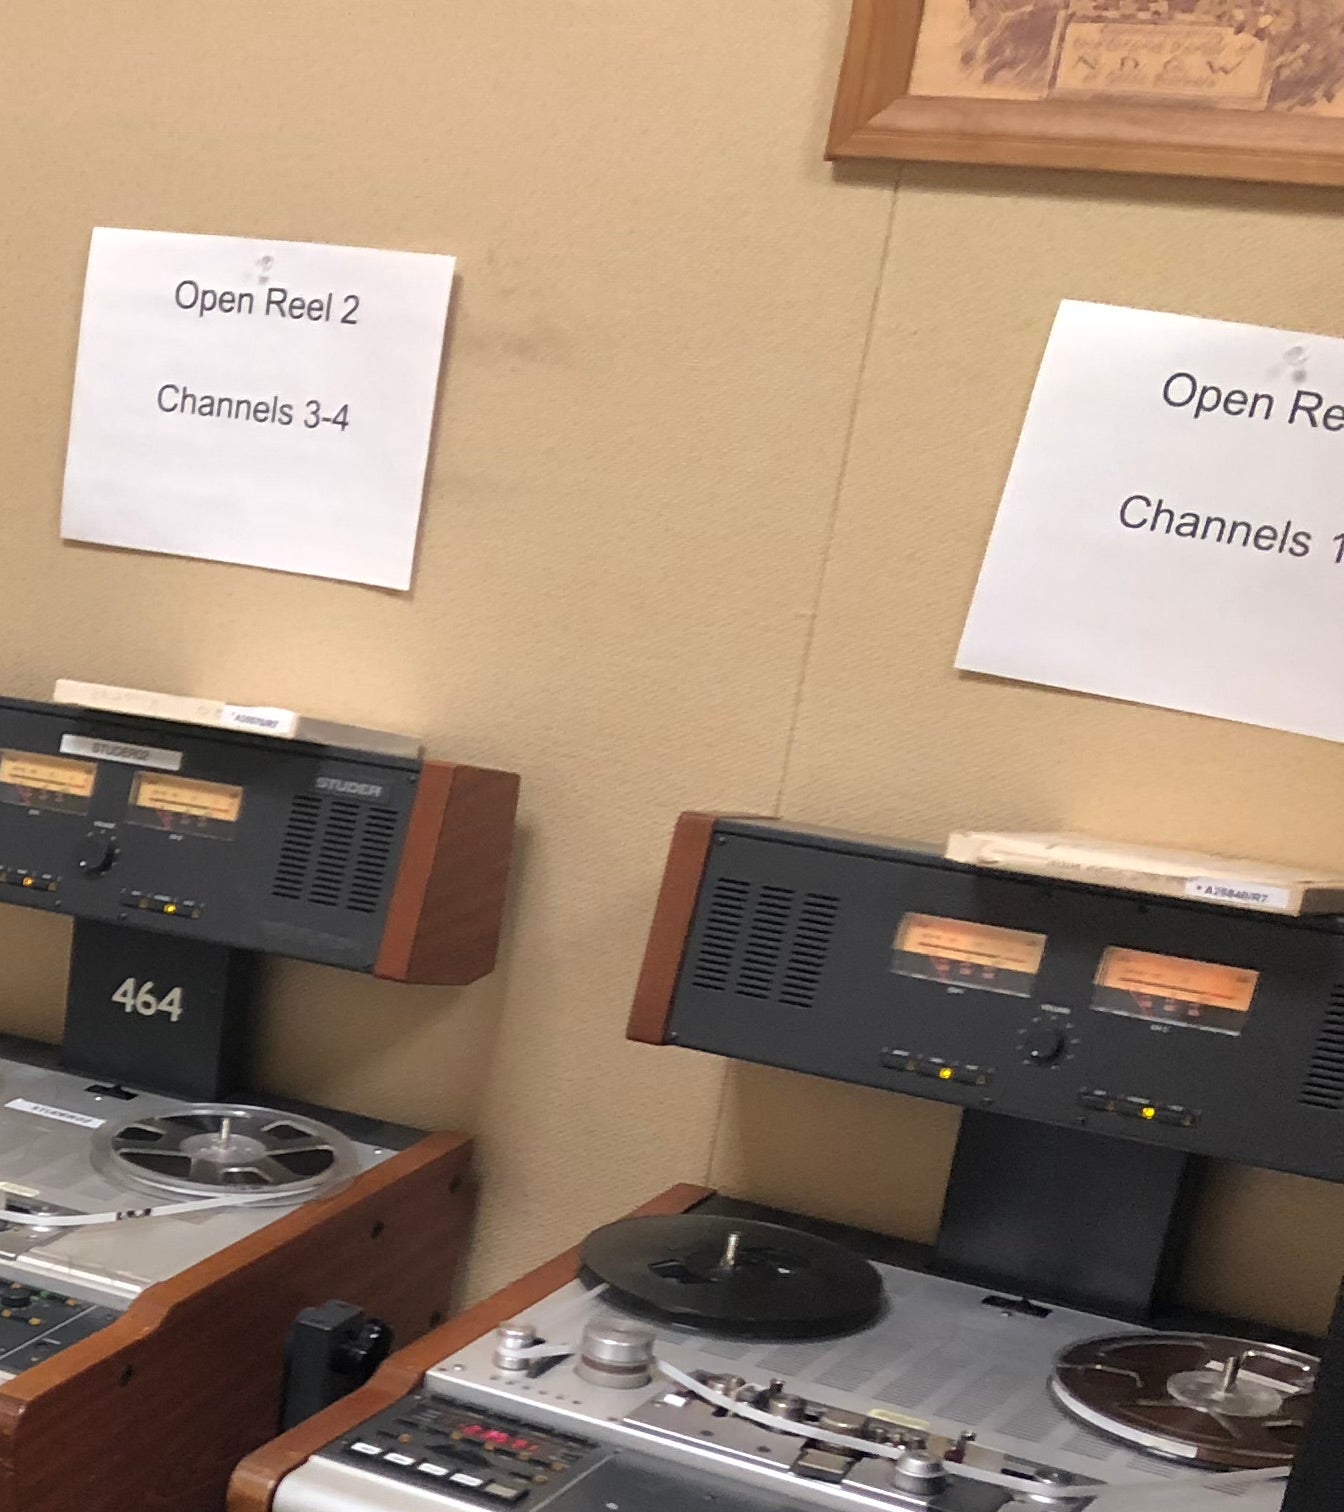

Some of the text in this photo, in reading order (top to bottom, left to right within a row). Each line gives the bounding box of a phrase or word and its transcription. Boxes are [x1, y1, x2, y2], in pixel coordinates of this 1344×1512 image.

[174, 280, 360, 324] Open Reel 2
[157, 384, 350, 431] Channels 3-4
[1163, 372, 1274, 419] Open
[1119, 494, 1312, 557] Channels
[315, 777, 383, 797] STUDER
[111, 977, 183, 1022] 464
